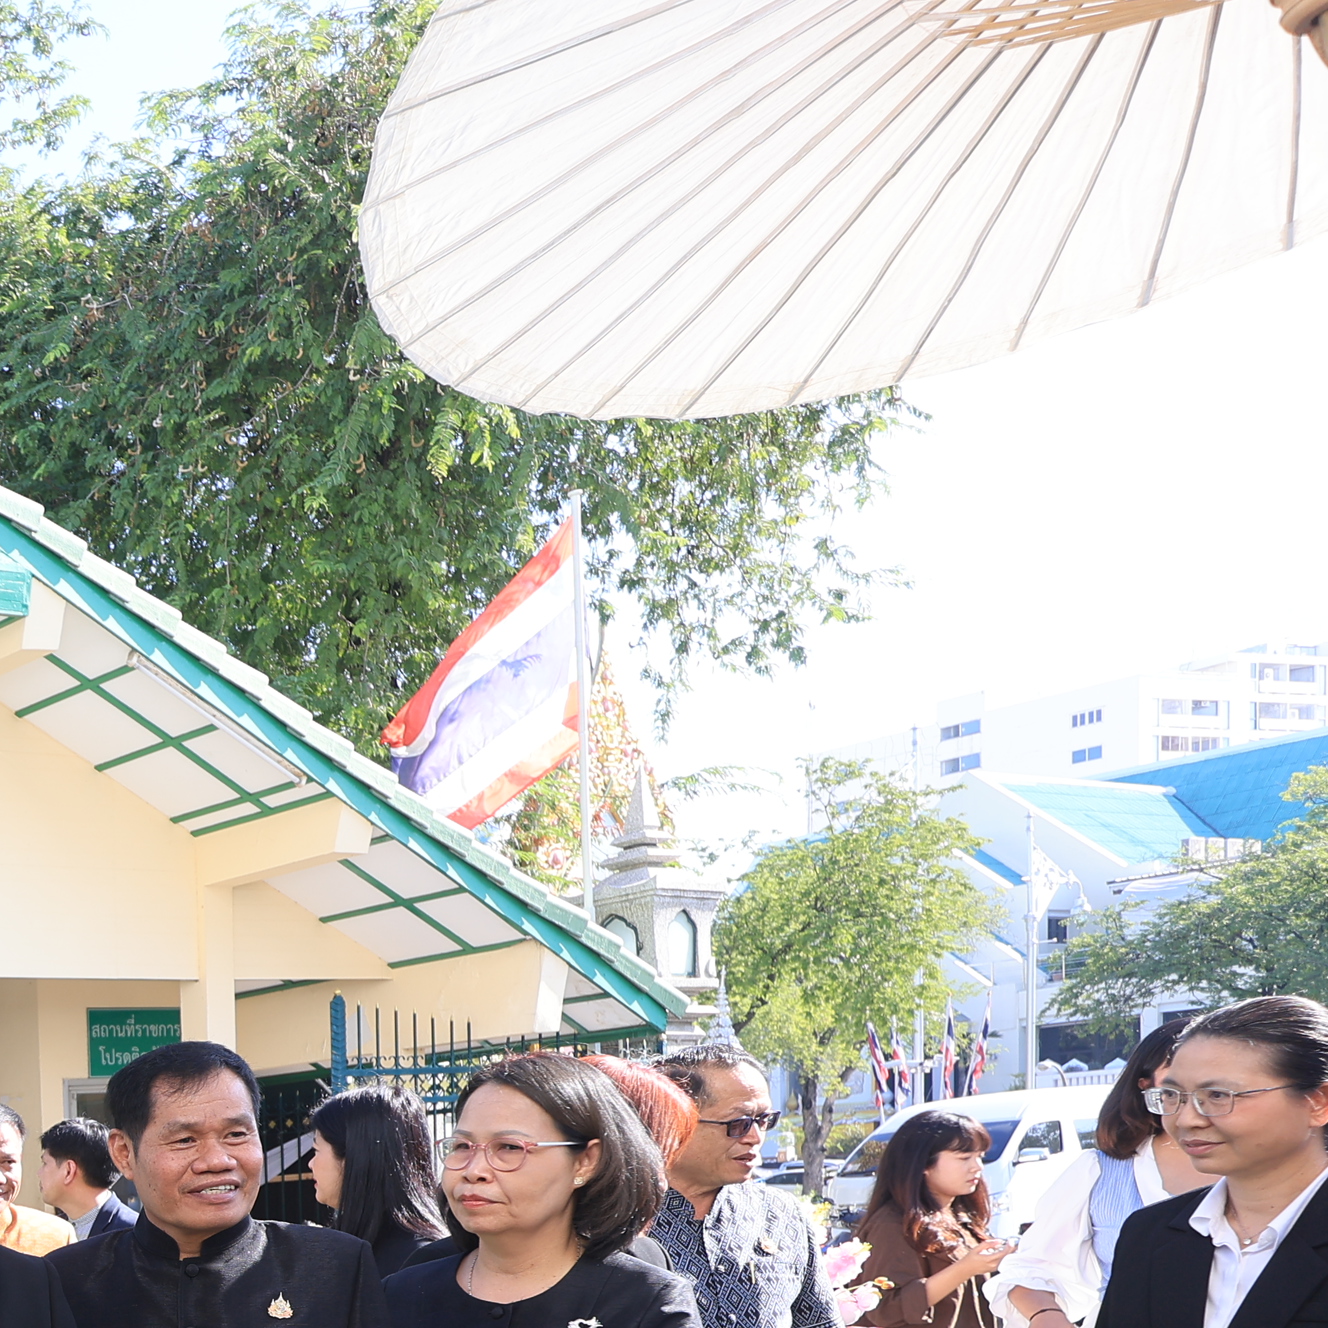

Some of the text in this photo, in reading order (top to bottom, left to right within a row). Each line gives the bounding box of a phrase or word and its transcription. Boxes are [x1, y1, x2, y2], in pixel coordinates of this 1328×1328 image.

[91, 1014, 180, 1037] สถานที่ราชการ
